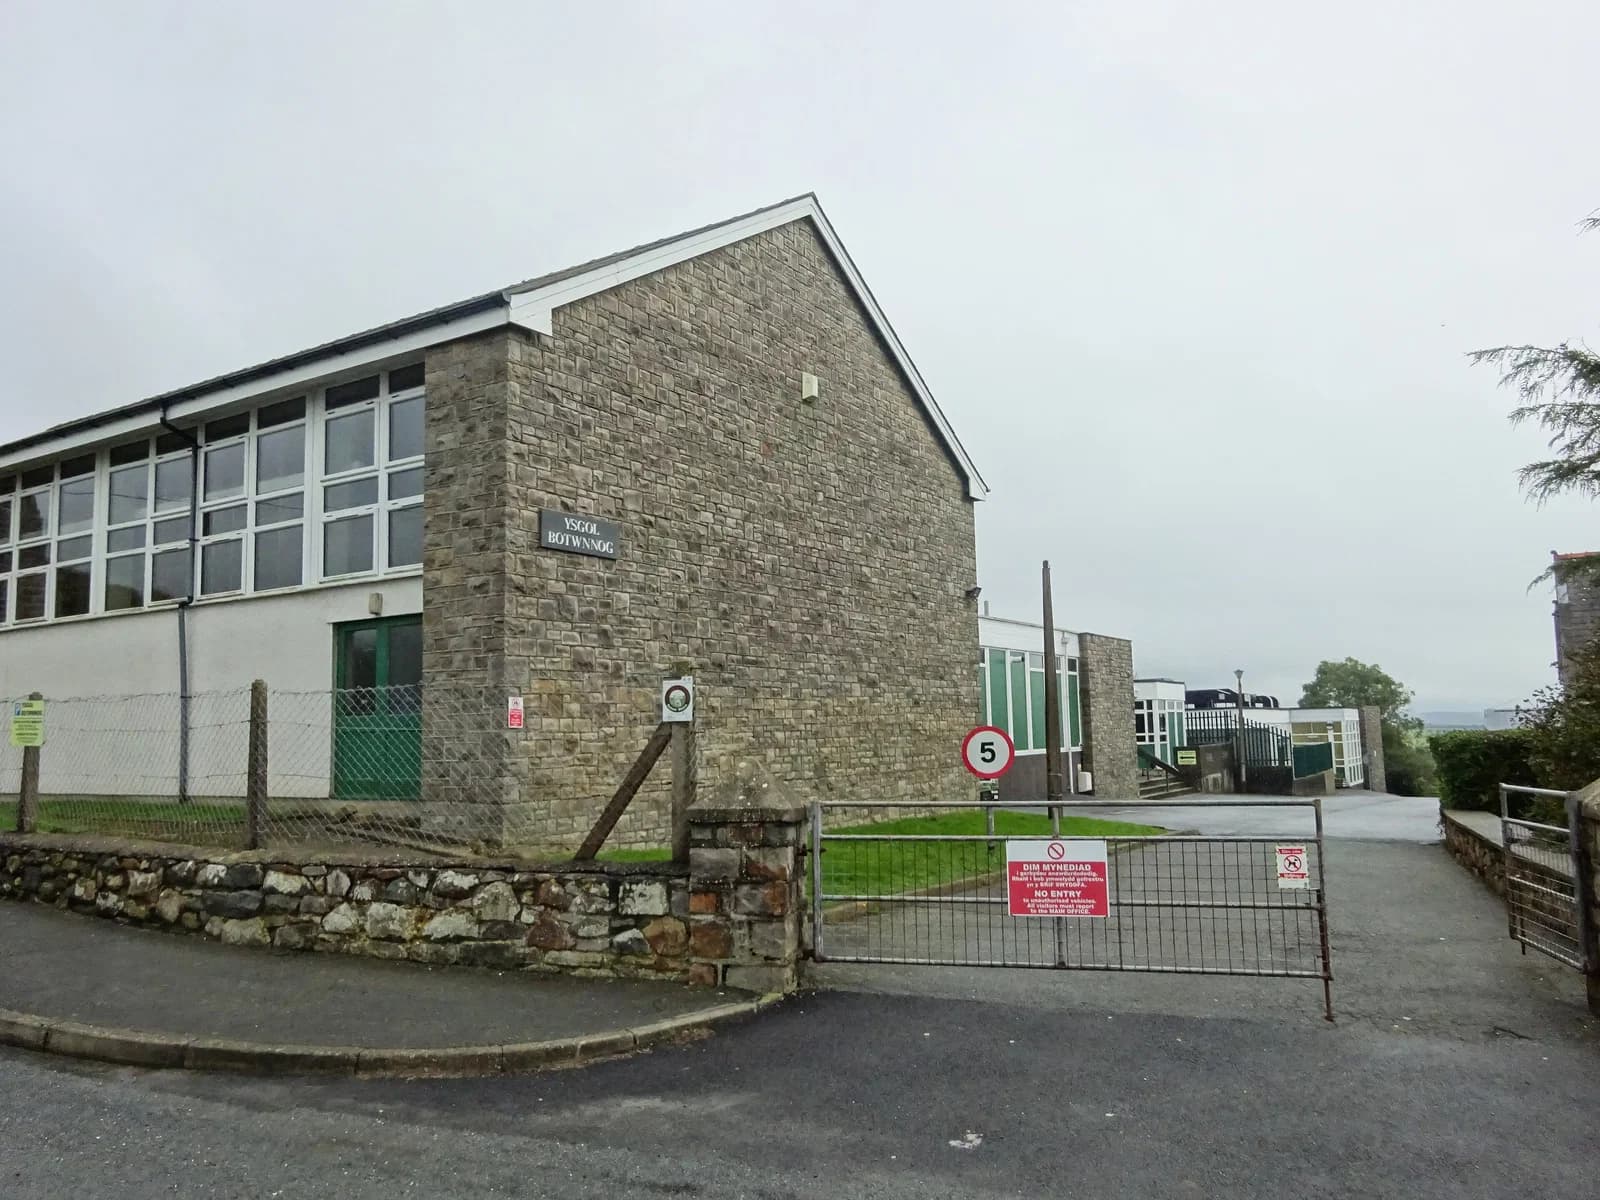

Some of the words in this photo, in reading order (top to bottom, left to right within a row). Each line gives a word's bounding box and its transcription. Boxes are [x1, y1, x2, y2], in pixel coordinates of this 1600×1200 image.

[564, 517, 600, 536] YSGOL
[548, 531, 614, 554] BOTWNNOG
[980, 742, 996, 764] 5
[1023, 863, 1040, 871] DIM
[1042, 863, 1091, 871] MYNEDIAD
